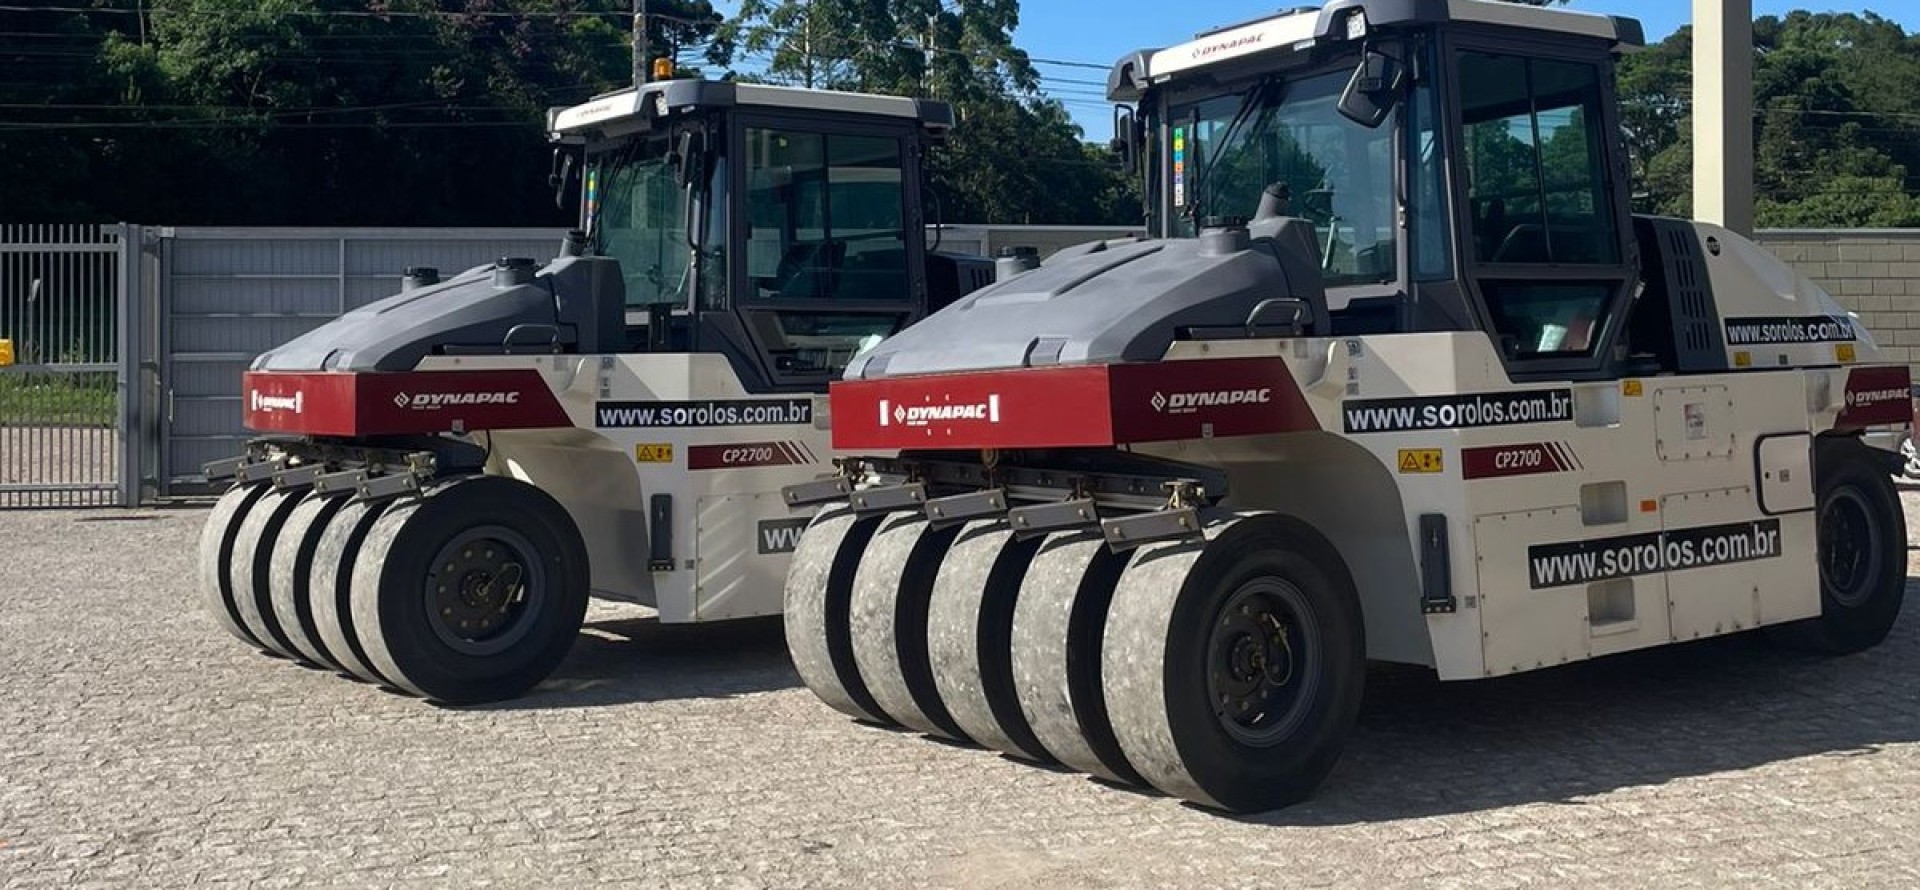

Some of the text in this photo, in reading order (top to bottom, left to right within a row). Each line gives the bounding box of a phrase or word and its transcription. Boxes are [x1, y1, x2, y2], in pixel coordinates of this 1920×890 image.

[412, 391, 519, 405] DYNAPAC
[1169, 388, 1270, 407] DYNAPAC
[1855, 387, 1910, 403] DYNAPAC
[599, 402, 809, 424] www.sorolos.com.br
[907, 404, 987, 420] DYNAPAC
[1347, 393, 1569, 429] www.sorolos.com.br
[722, 447, 772, 463] CP2700
[1495, 449, 1542, 469] CP2700
[1533, 522, 1777, 583] www.sorolos.com.br
